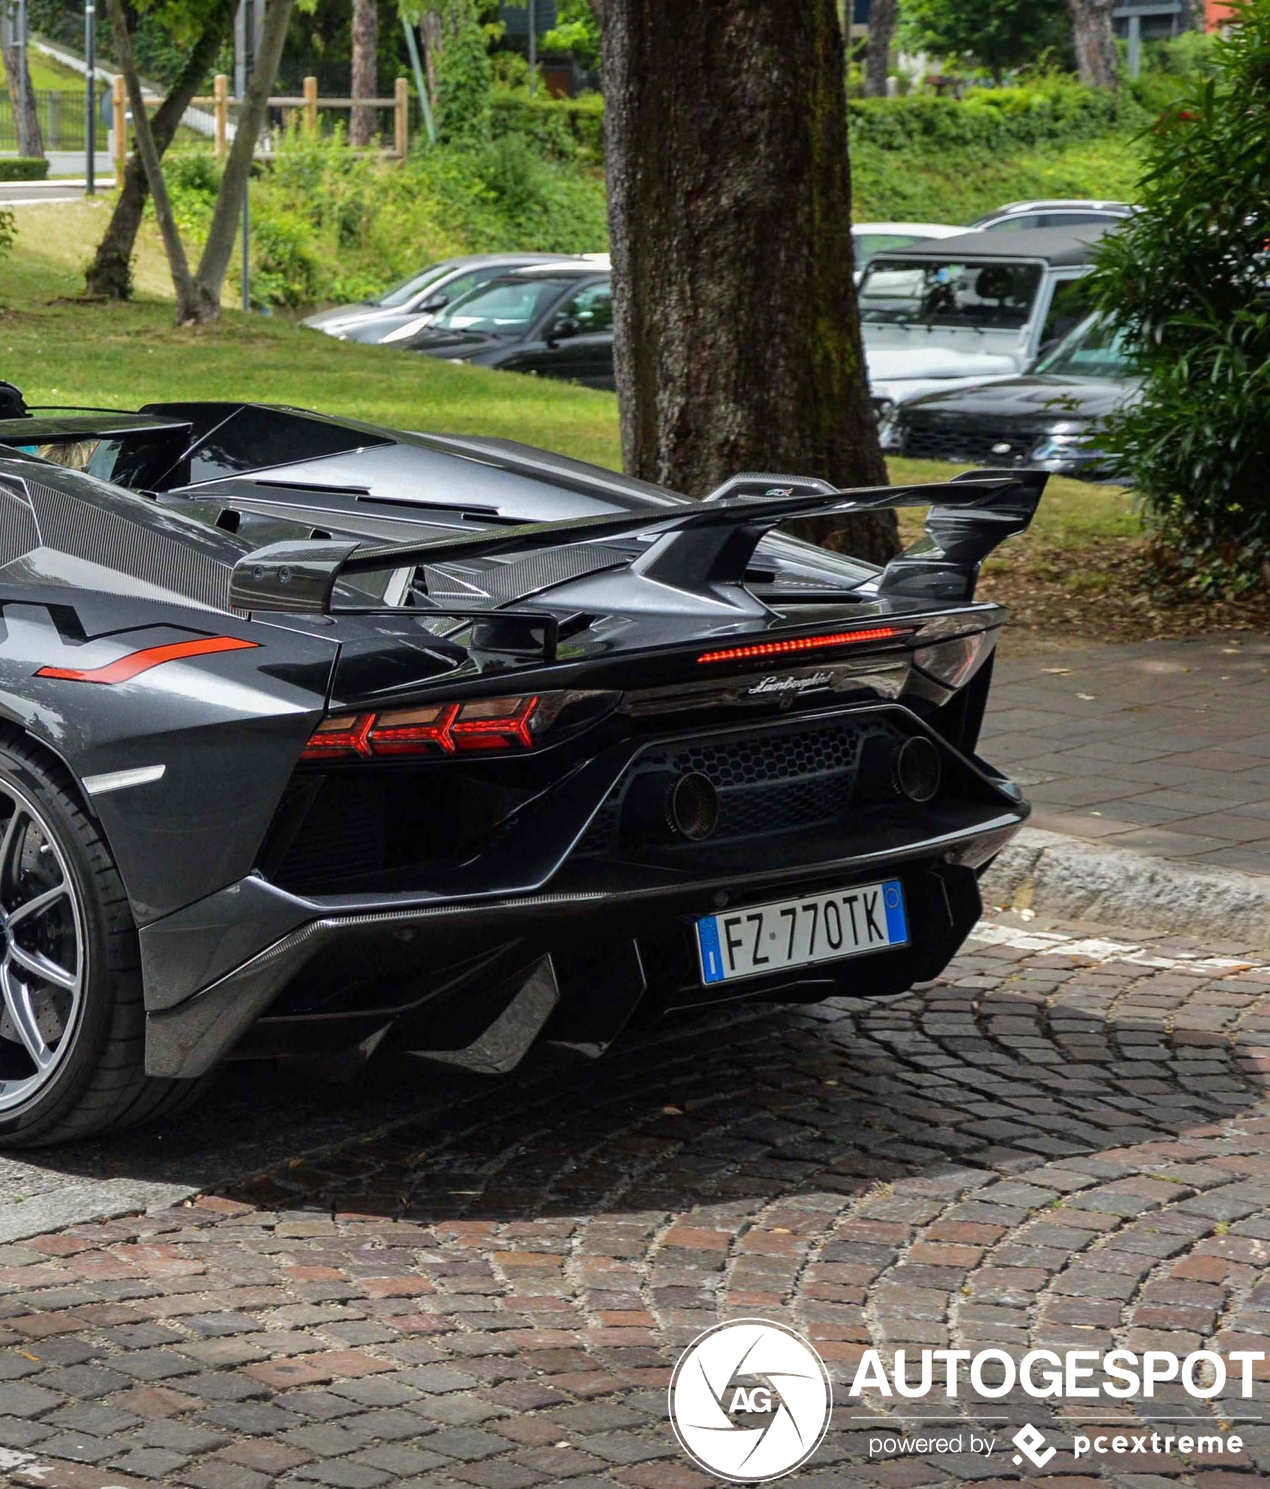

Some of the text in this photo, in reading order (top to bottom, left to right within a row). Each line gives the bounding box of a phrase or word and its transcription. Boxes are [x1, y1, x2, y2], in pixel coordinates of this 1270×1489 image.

[748, 671, 834, 695] Lamborghini
[723, 912, 770, 971] FZ
[780, 890, 884, 961] 770TK
